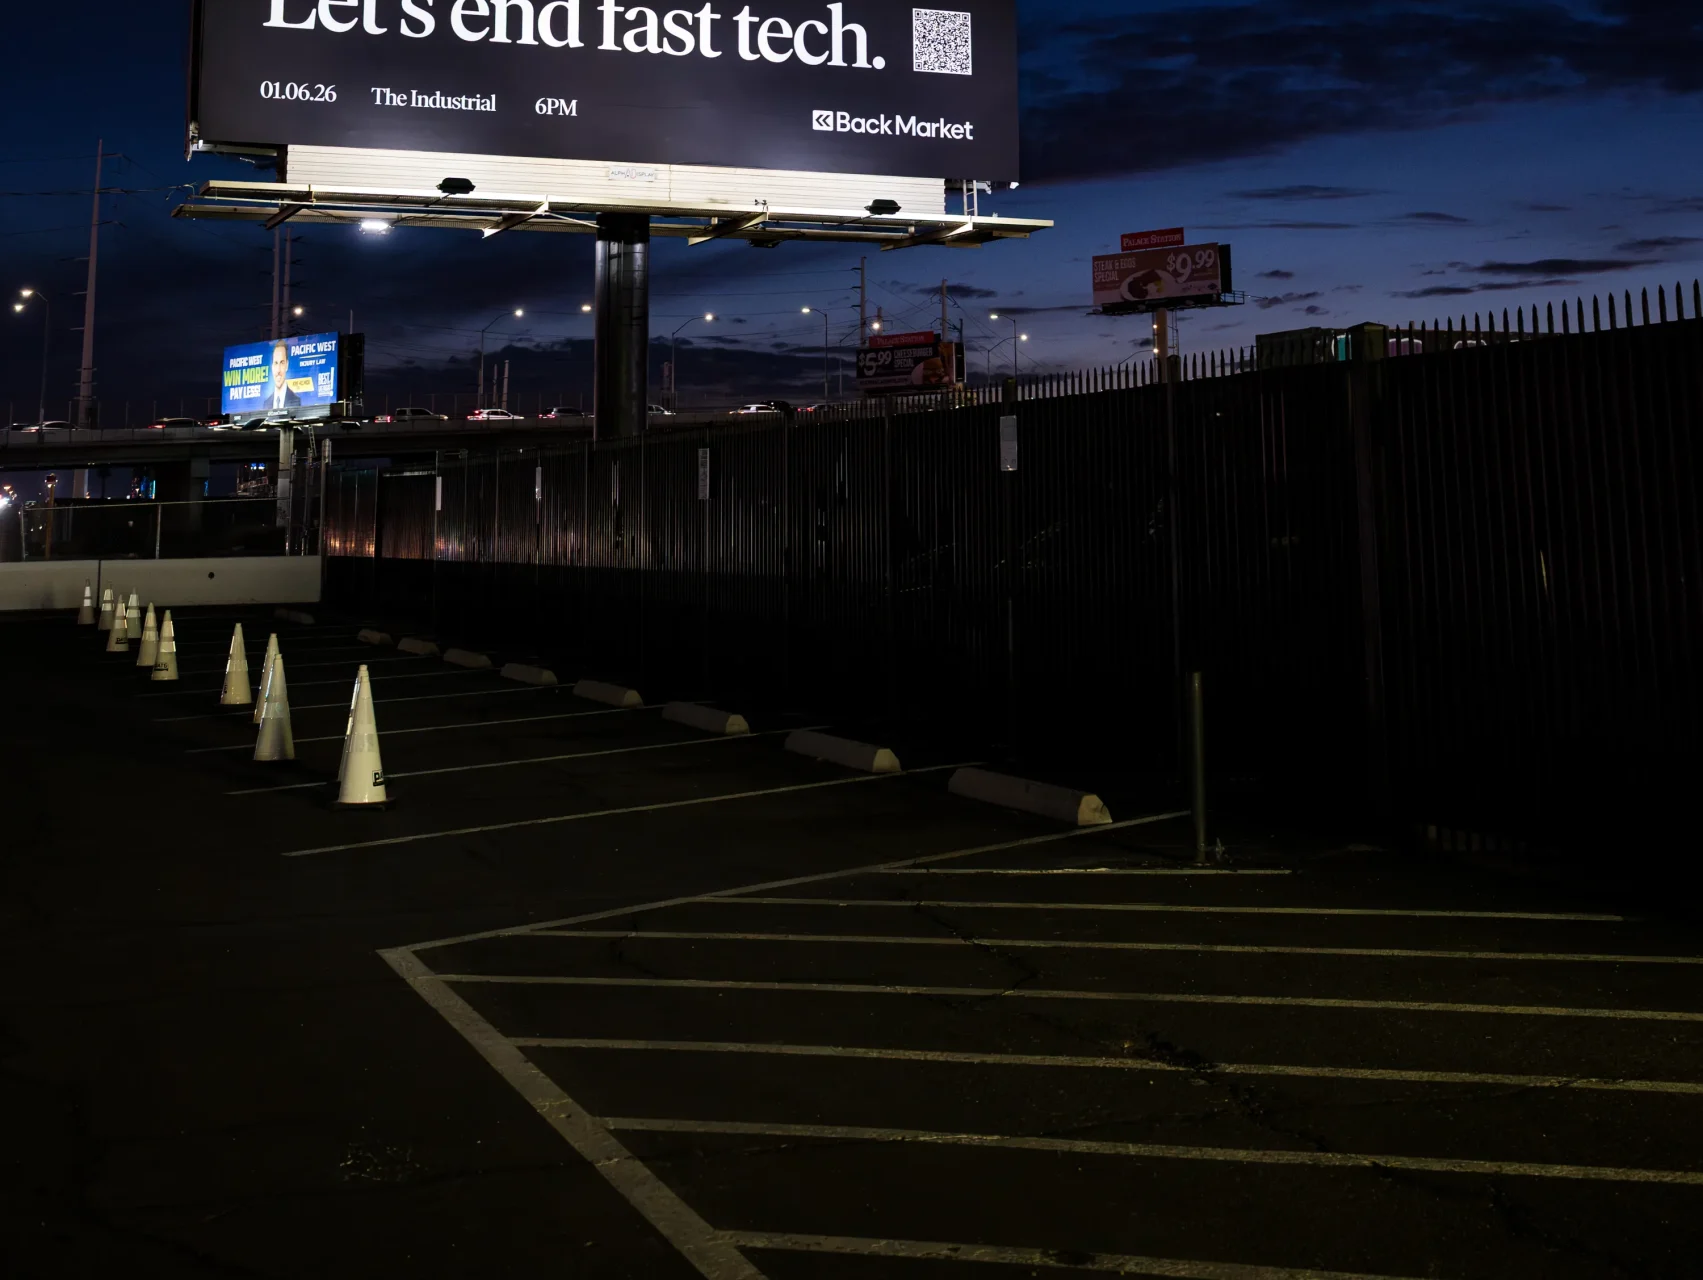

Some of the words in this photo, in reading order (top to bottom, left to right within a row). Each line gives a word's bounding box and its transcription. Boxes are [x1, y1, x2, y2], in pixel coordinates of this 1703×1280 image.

[732, 2, 886, 70] tech.
[260, 80, 338, 103] 01.06.26
[370, 87, 408, 107] The
[410, 89, 497, 112] Industrial
[534, 97, 578, 117] 6PM
[836, 111, 893, 136] Back
[895, 114, 974, 141] Market
[1094, 260, 1113, 271] STEAK
[1166, 249, 1215, 284] $9.99
[1094, 271, 1119, 282] SPECIAL
[291, 343, 316, 356] PACIFIC
[317, 341, 336, 352] WEST
[229, 356, 248, 368] PACIFIC
[249, 355, 263, 366] WEST
[224, 369, 241, 387] WIN
[242, 366, 269, 384] MORE!
[229, 387, 243, 400] PAY
[244, 385, 261, 399] LESS!
